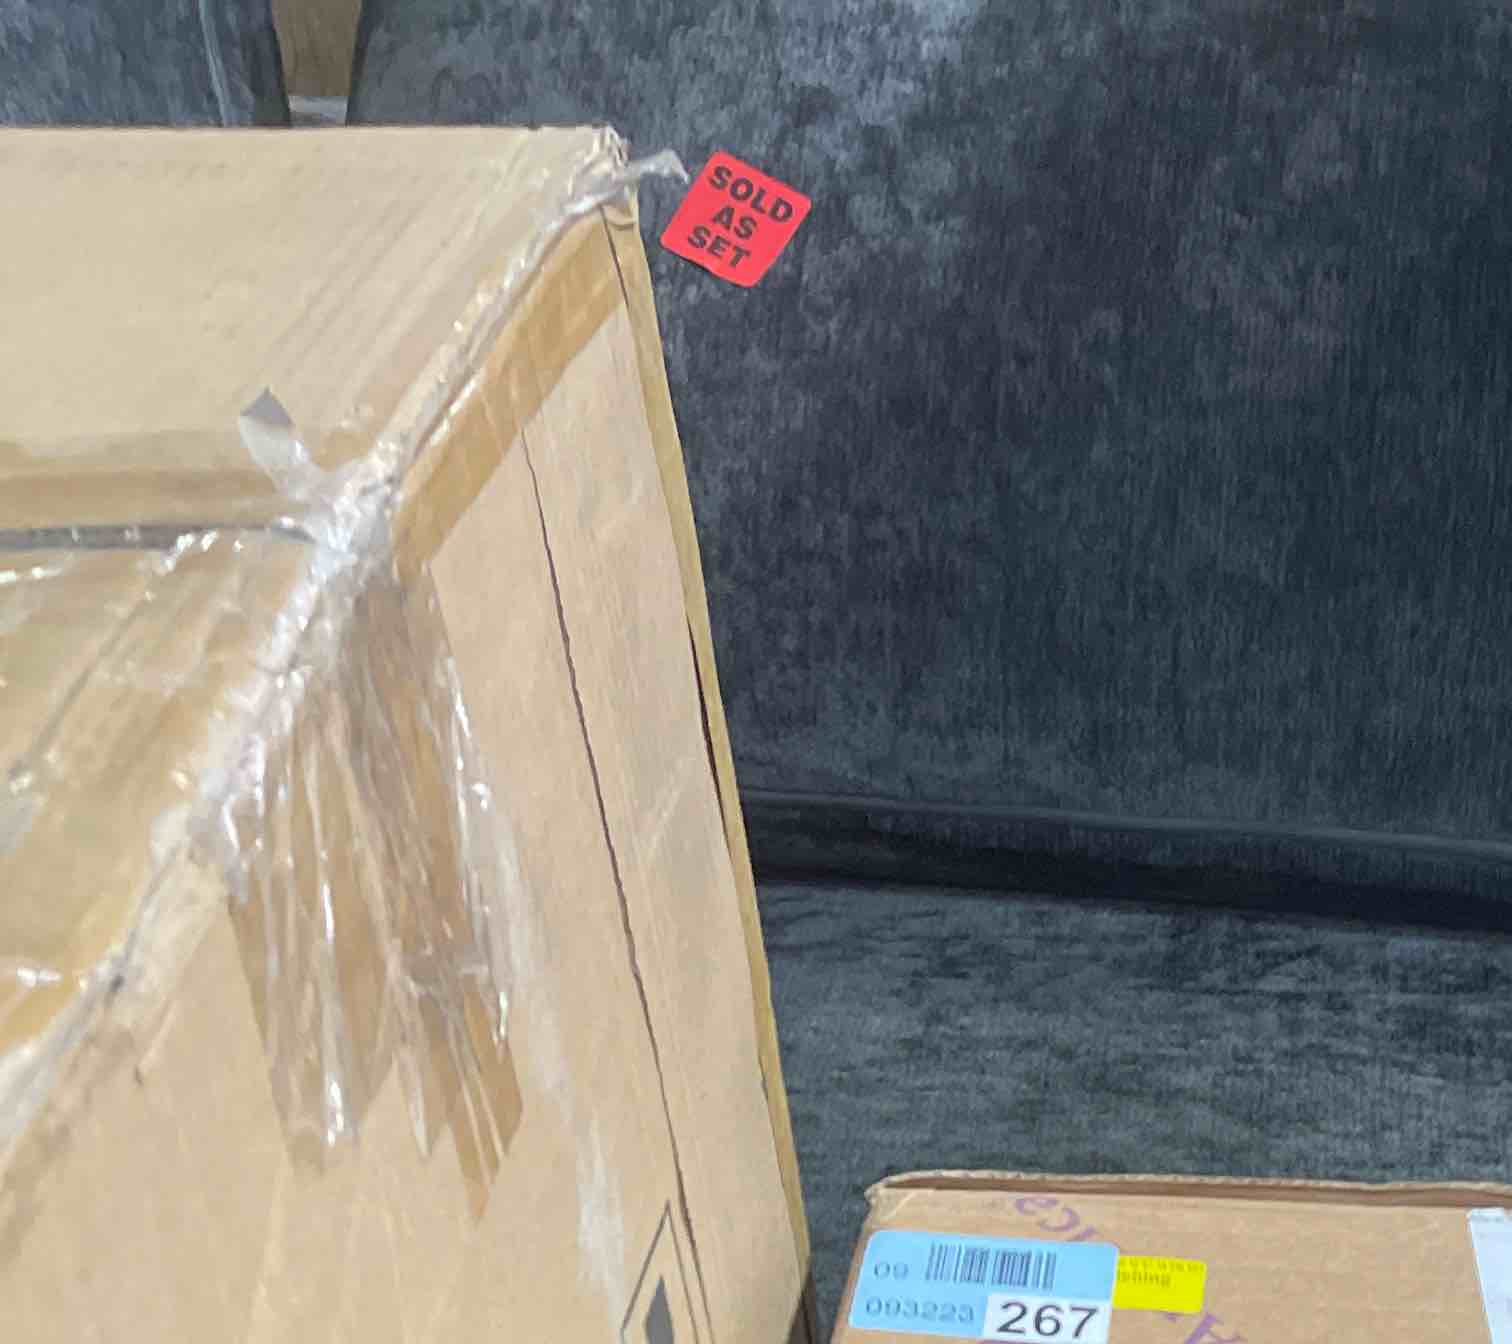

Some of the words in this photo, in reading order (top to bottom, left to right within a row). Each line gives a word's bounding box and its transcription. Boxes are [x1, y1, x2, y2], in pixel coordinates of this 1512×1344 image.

[708, 165, 794, 223] SOLD
[712, 205, 757, 241] AS
[687, 224, 752, 268] SET
[995, 1301, 1099, 1341] 267
